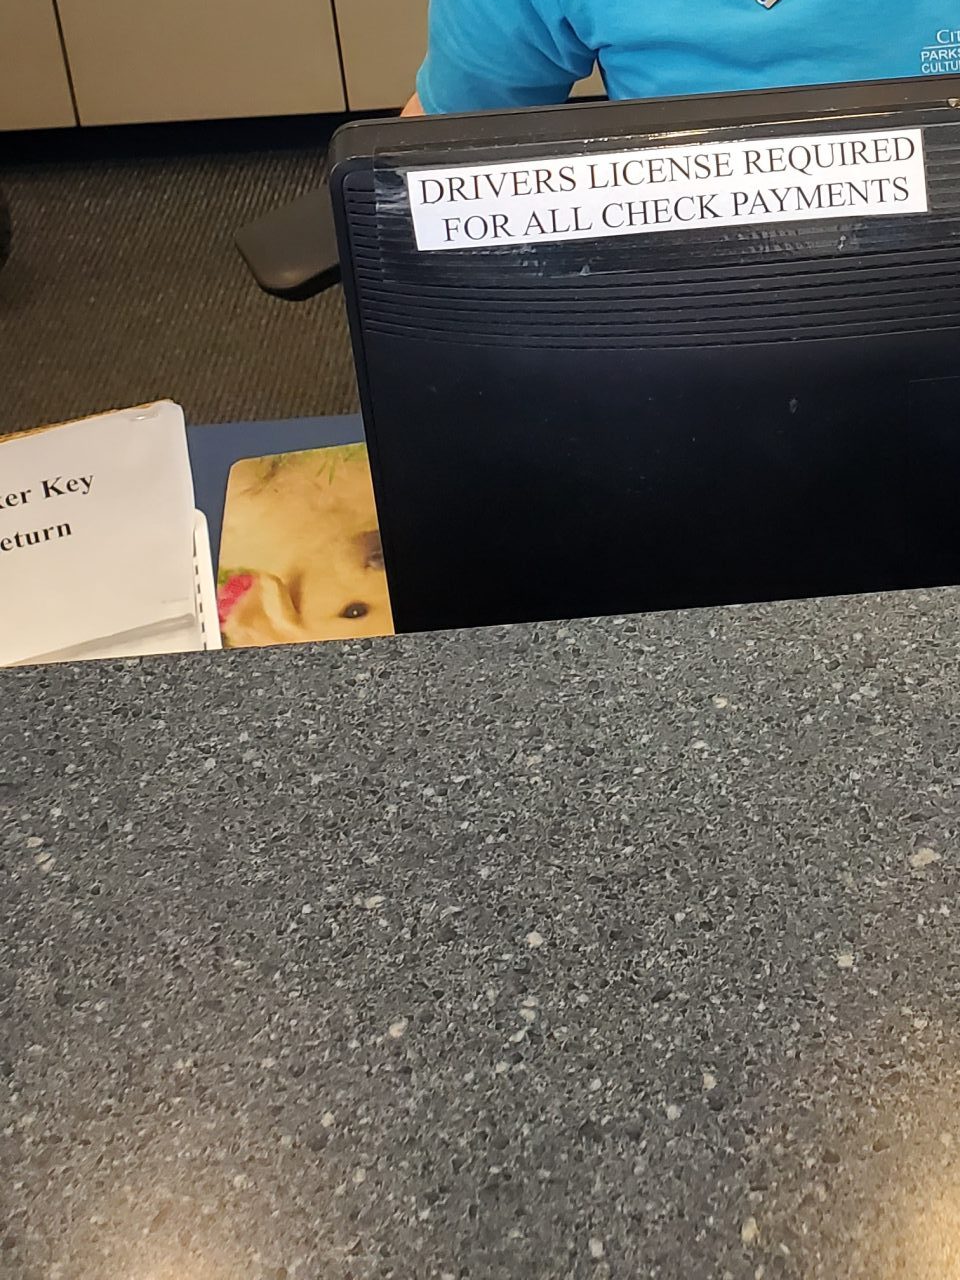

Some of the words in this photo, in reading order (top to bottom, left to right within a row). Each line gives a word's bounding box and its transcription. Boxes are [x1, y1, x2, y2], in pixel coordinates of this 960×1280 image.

[420, 164, 579, 207] DRIVERS
[588, 152, 735, 190] LICENSE
[744, 135, 917, 176] REQUIRED
[443, 213, 515, 243] FOR
[522, 208, 595, 237] ALL
[602, 196, 723, 229] CHECK
[731, 176, 910, 217] PAYMENTS
[40, 475, 94, 499] Key
[0, 522, 72, 552] eturn
